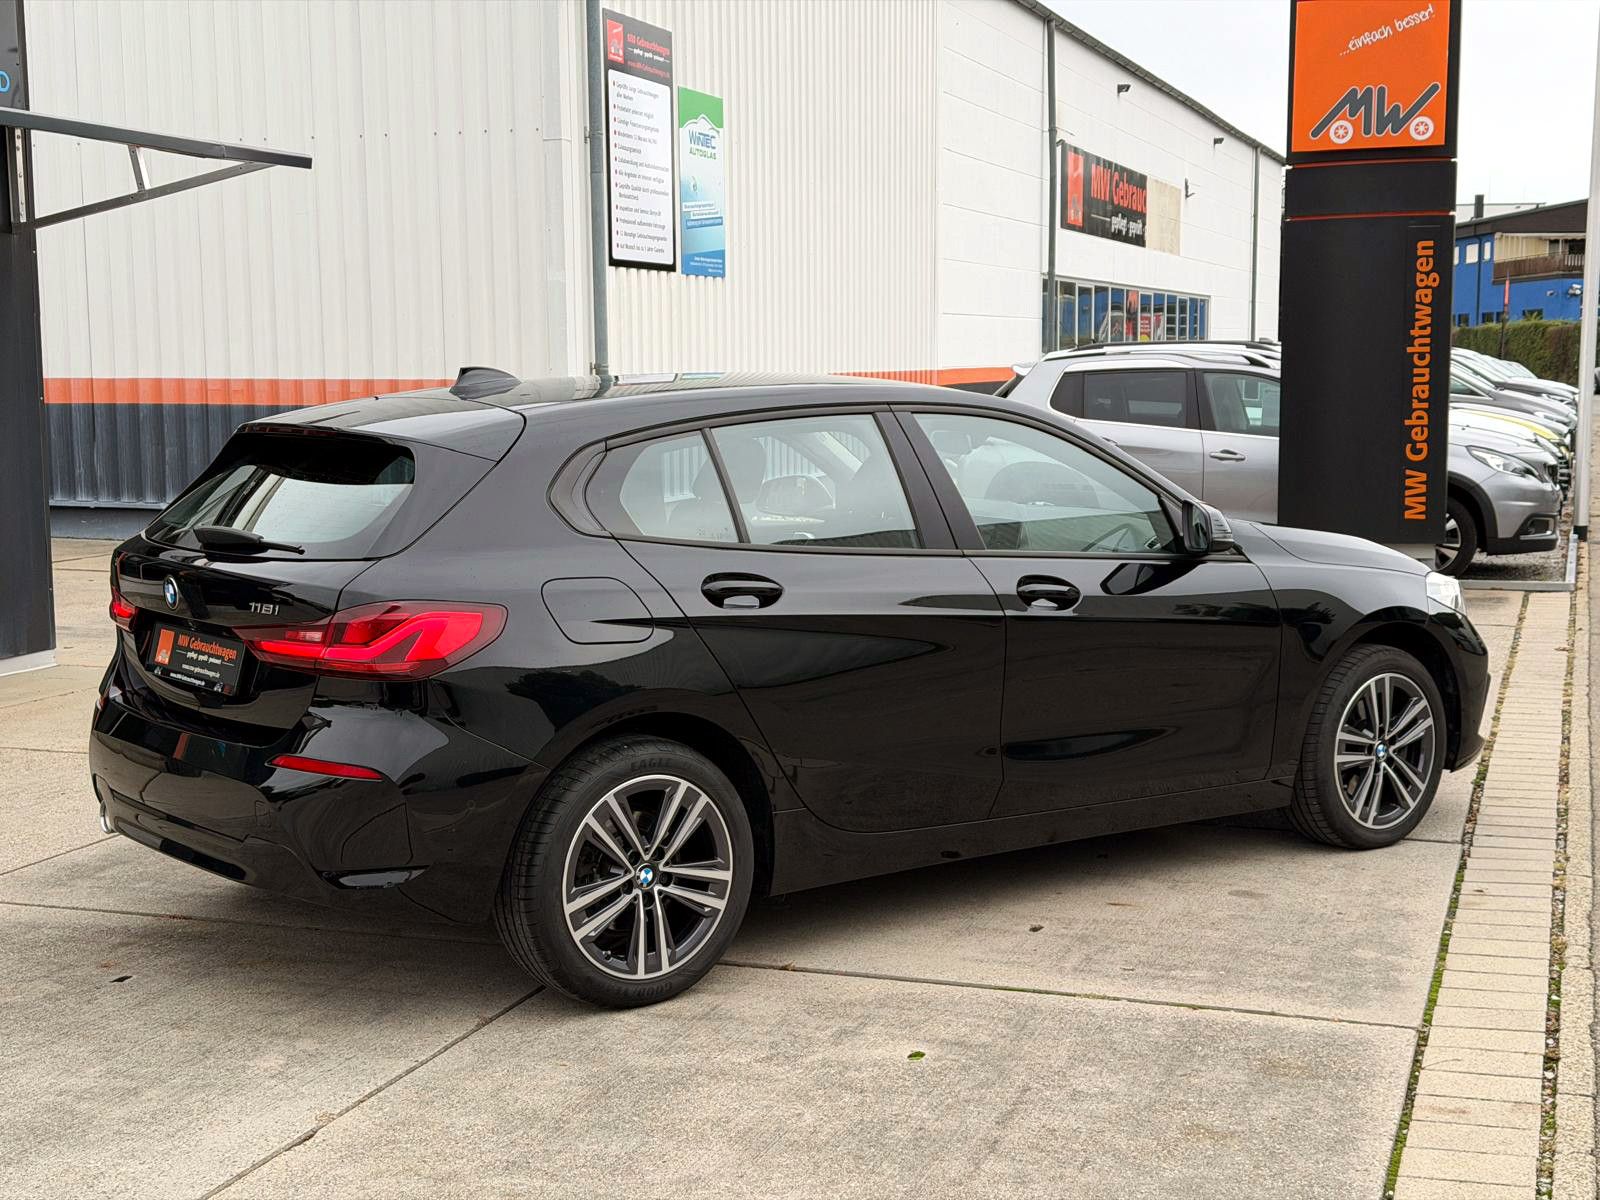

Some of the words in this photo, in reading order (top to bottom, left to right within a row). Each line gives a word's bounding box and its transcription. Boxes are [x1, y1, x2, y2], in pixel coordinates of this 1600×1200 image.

[1394, 3, 1436, 32] besser!
[1309, 82, 1441, 140] MW
[689, 147, 717, 160] AUTOGLAS
[1091, 163, 1111, 202] MW
[1404, 240, 1439, 462] Gebrauchtwagen
[1404, 469, 1427, 520] MW
[177, 634, 190, 648] MW
[189, 637, 237, 661] Gebrauchtwagen
[630, 757, 673, 772] EAGLE
